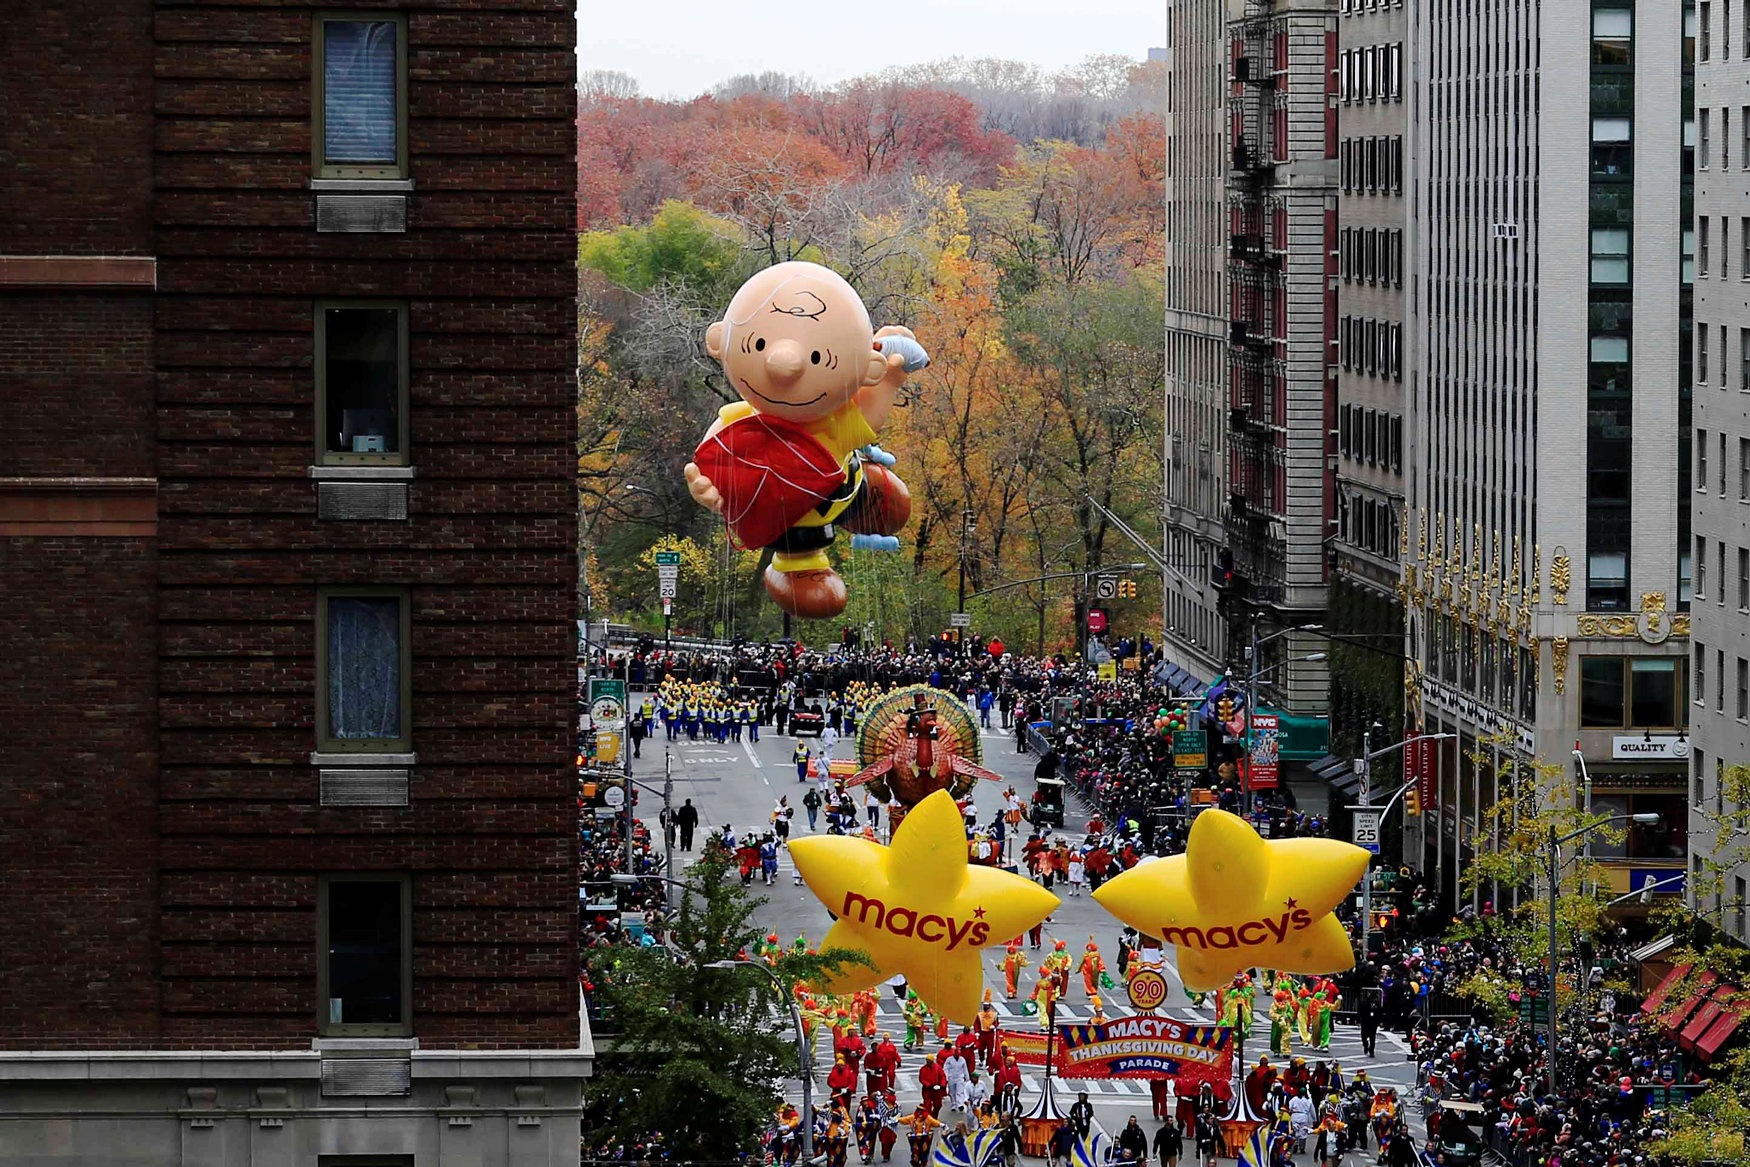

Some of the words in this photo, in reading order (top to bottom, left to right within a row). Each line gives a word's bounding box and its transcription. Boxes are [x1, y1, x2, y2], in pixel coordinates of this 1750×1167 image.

[1254, 718, 1276, 727] NYC
[1620, 744, 1666, 752] QUALITY
[1356, 830, 1376, 840] 25
[1134, 980, 1162, 999] 90
[1108, 1019, 1182, 1040] MACY'S
[1070, 1042, 1186, 1062] THANKSGIVING
[1187, 1046, 1220, 1064] DAY
[1119, 1058, 1170, 1070] PARADE
